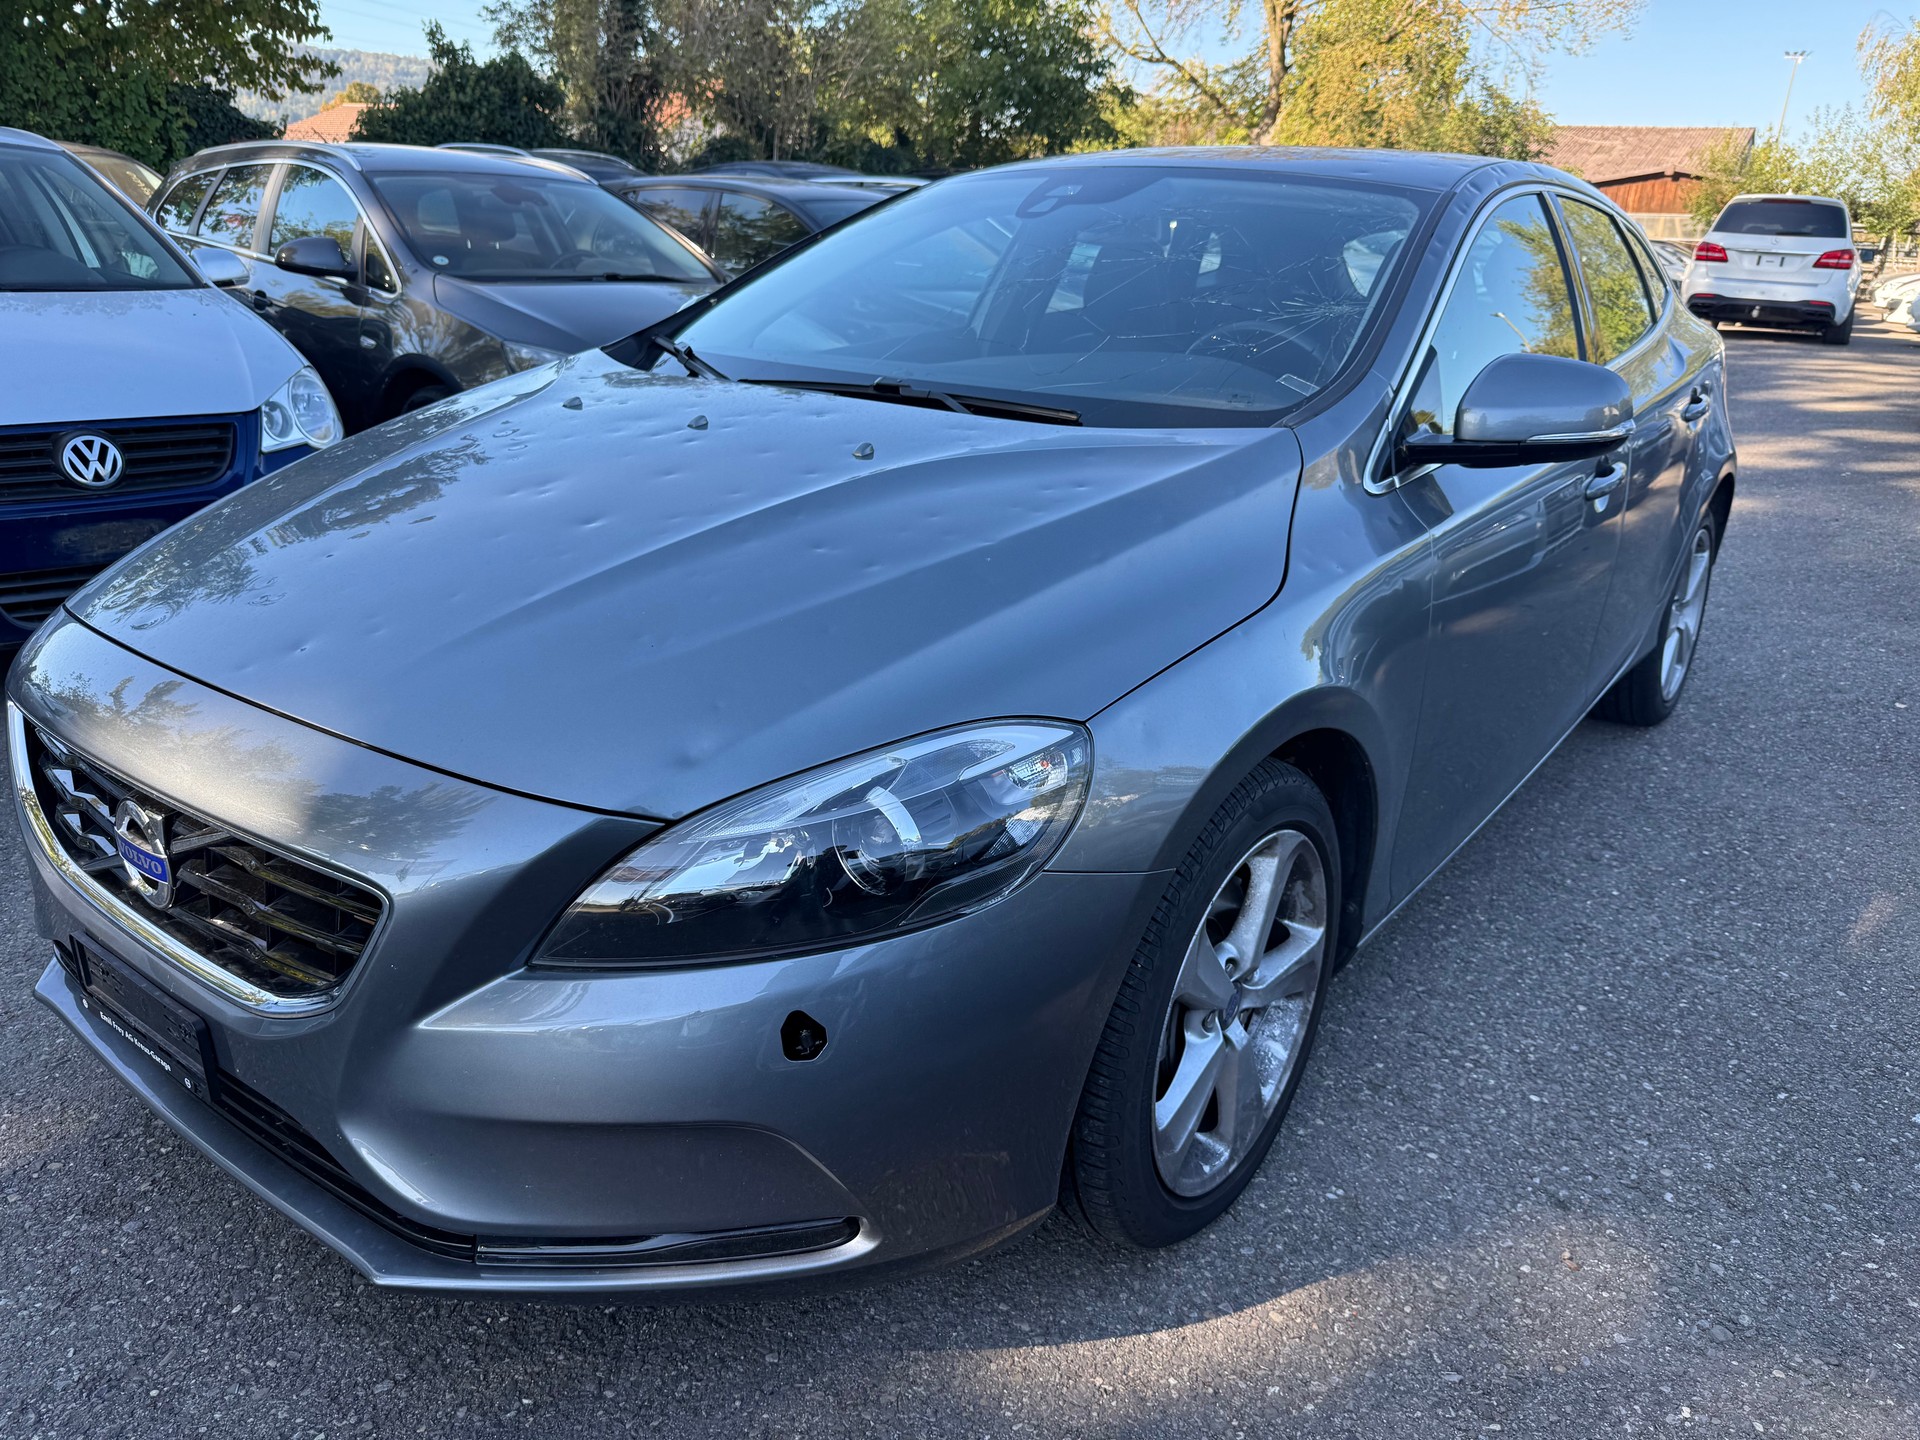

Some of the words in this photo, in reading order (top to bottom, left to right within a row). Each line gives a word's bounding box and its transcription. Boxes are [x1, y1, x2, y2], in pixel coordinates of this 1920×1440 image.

[63, 435, 123, 486] VW
[118, 840, 162, 874] VOLVO
[100, 1011, 112, 1026] Emil
[112, 1021, 124, 1036] Frey
